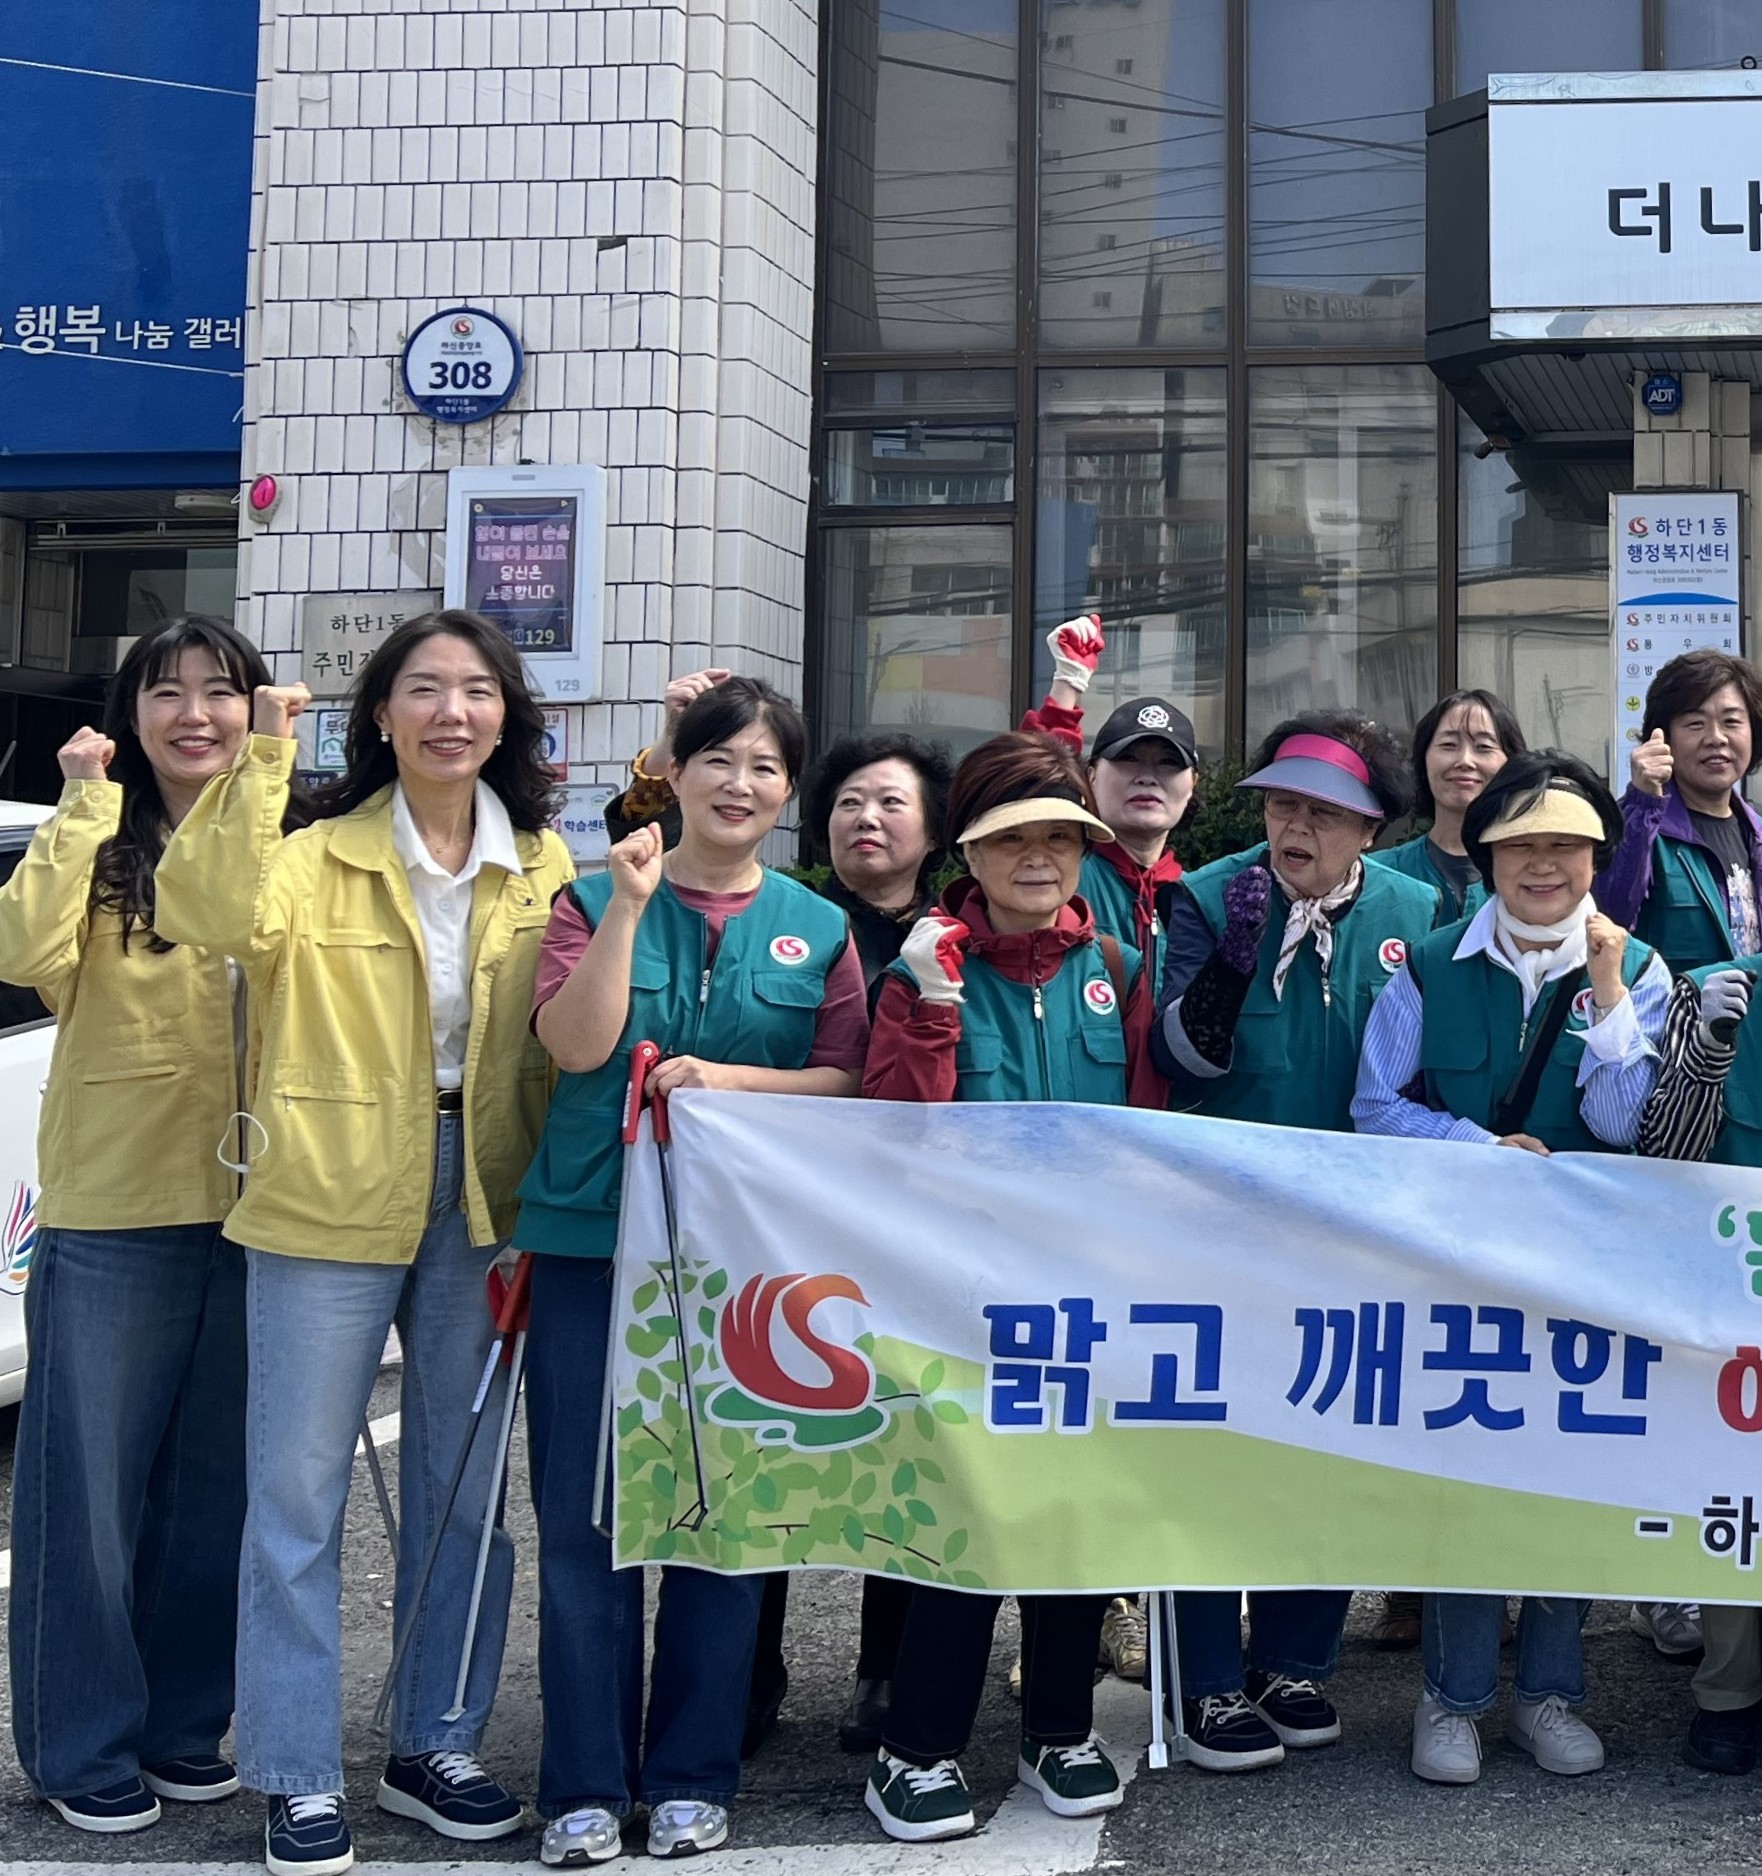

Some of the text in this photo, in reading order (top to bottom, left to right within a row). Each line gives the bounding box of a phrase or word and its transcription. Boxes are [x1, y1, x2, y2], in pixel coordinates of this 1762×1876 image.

[1607, 181, 1671, 254] 더
[14, 304, 107, 355] 행복
[115, 319, 174, 350] 나눔
[428, 361, 492, 390] 308
[1648, 388, 1675, 403] ADT
[1655, 517, 1728, 537] 하단1동
[1626, 543, 1730, 564] 행정복지센터
[500, 564, 542, 581] 당신은
[485, 584, 555, 600] 소중합니다
[1643, 613, 1732, 625] 주민자치위원회
[525, 628, 556, 645] 129
[554, 679, 581, 692] 129
[982, 1297, 1228, 1428] 맑고
[1286, 1301, 1663, 1436] 깨끗한
